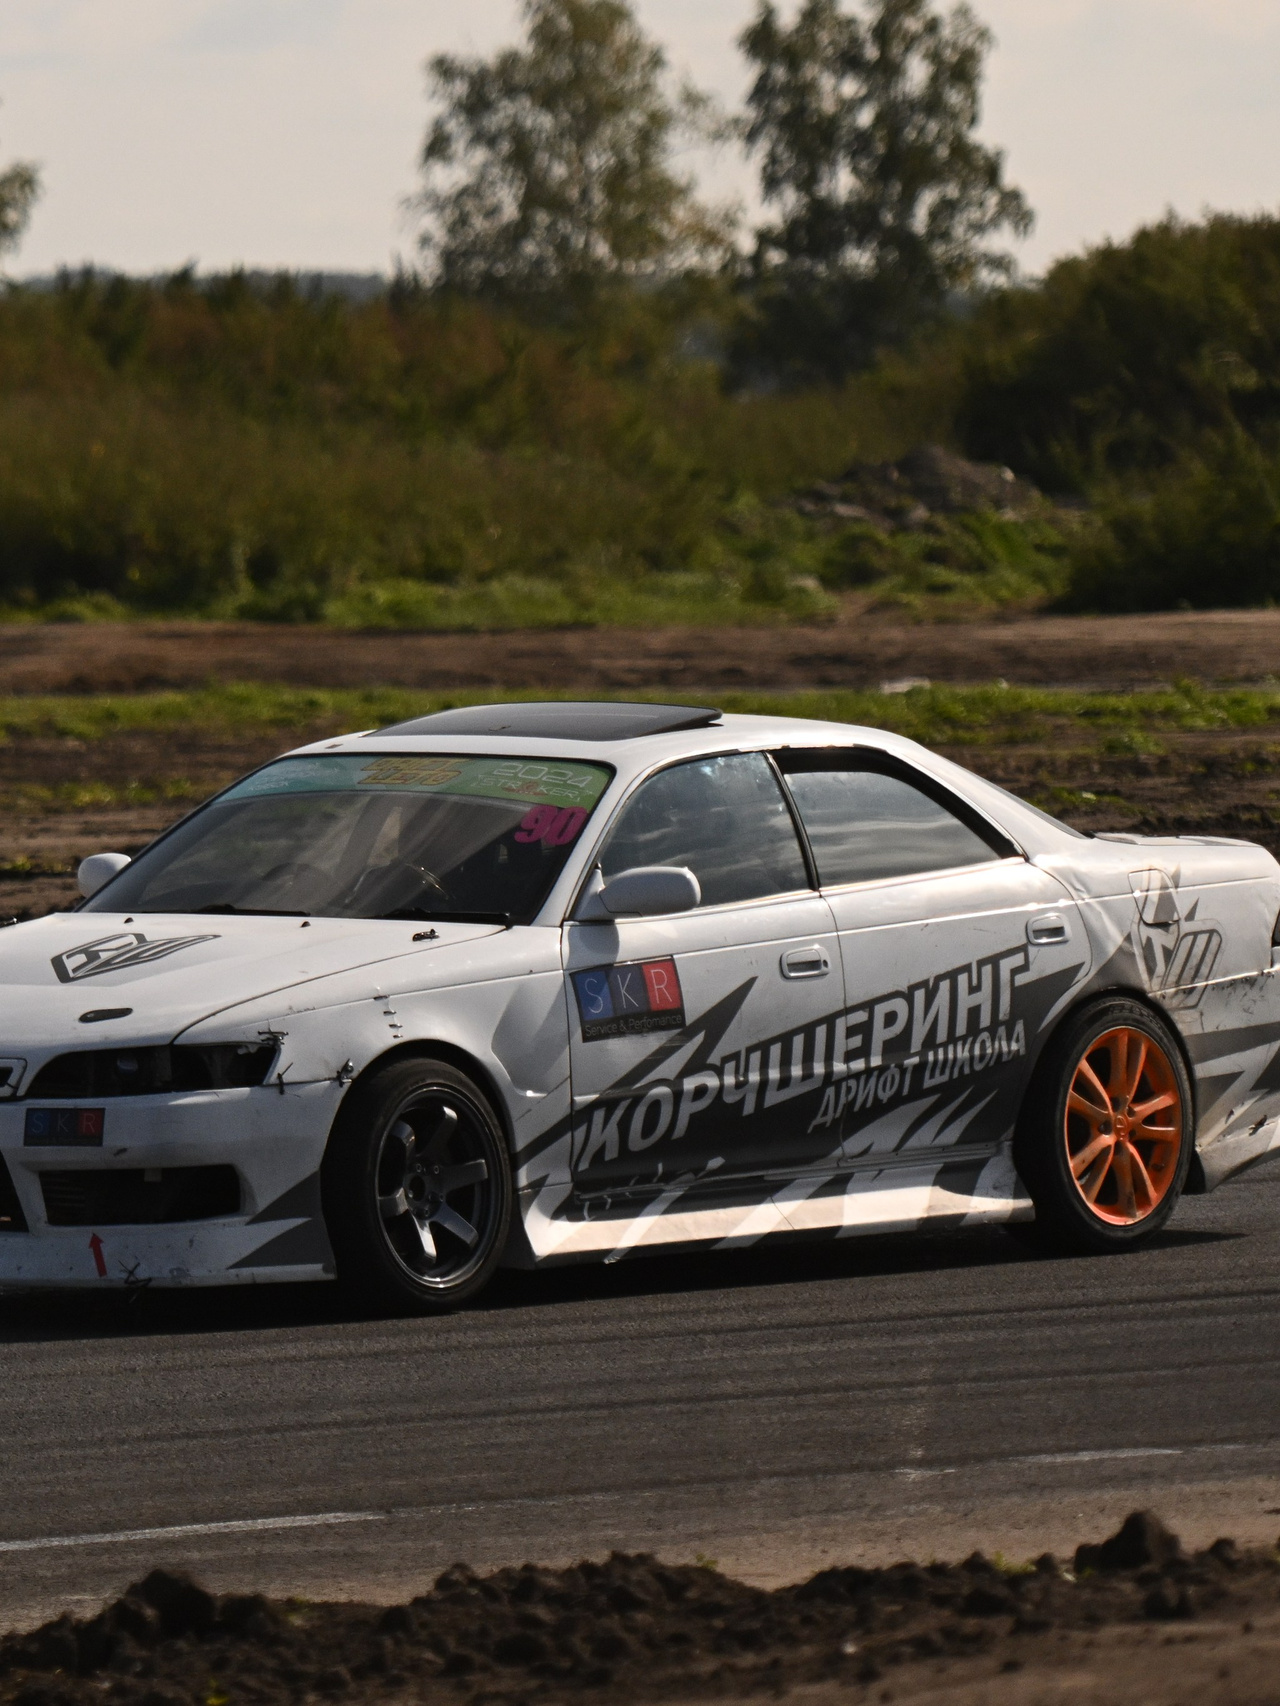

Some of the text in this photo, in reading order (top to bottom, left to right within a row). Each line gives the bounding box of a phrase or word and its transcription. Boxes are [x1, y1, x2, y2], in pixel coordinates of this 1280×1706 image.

[480, 777, 581, 799] STRKER
[493, 762, 593, 788] 2024
[514, 805, 588, 846] 90
[584, 968, 673, 1014] SKR
[585, 1023, 618, 1037] Service
[619, 1019, 627, 1032] &
[578, 957, 1030, 1171] КОРЧШЕРИНГ
[806, 1019, 1027, 1134] ДРИФТ ШКОЛА
[31, 1112, 96, 1134] SKR
